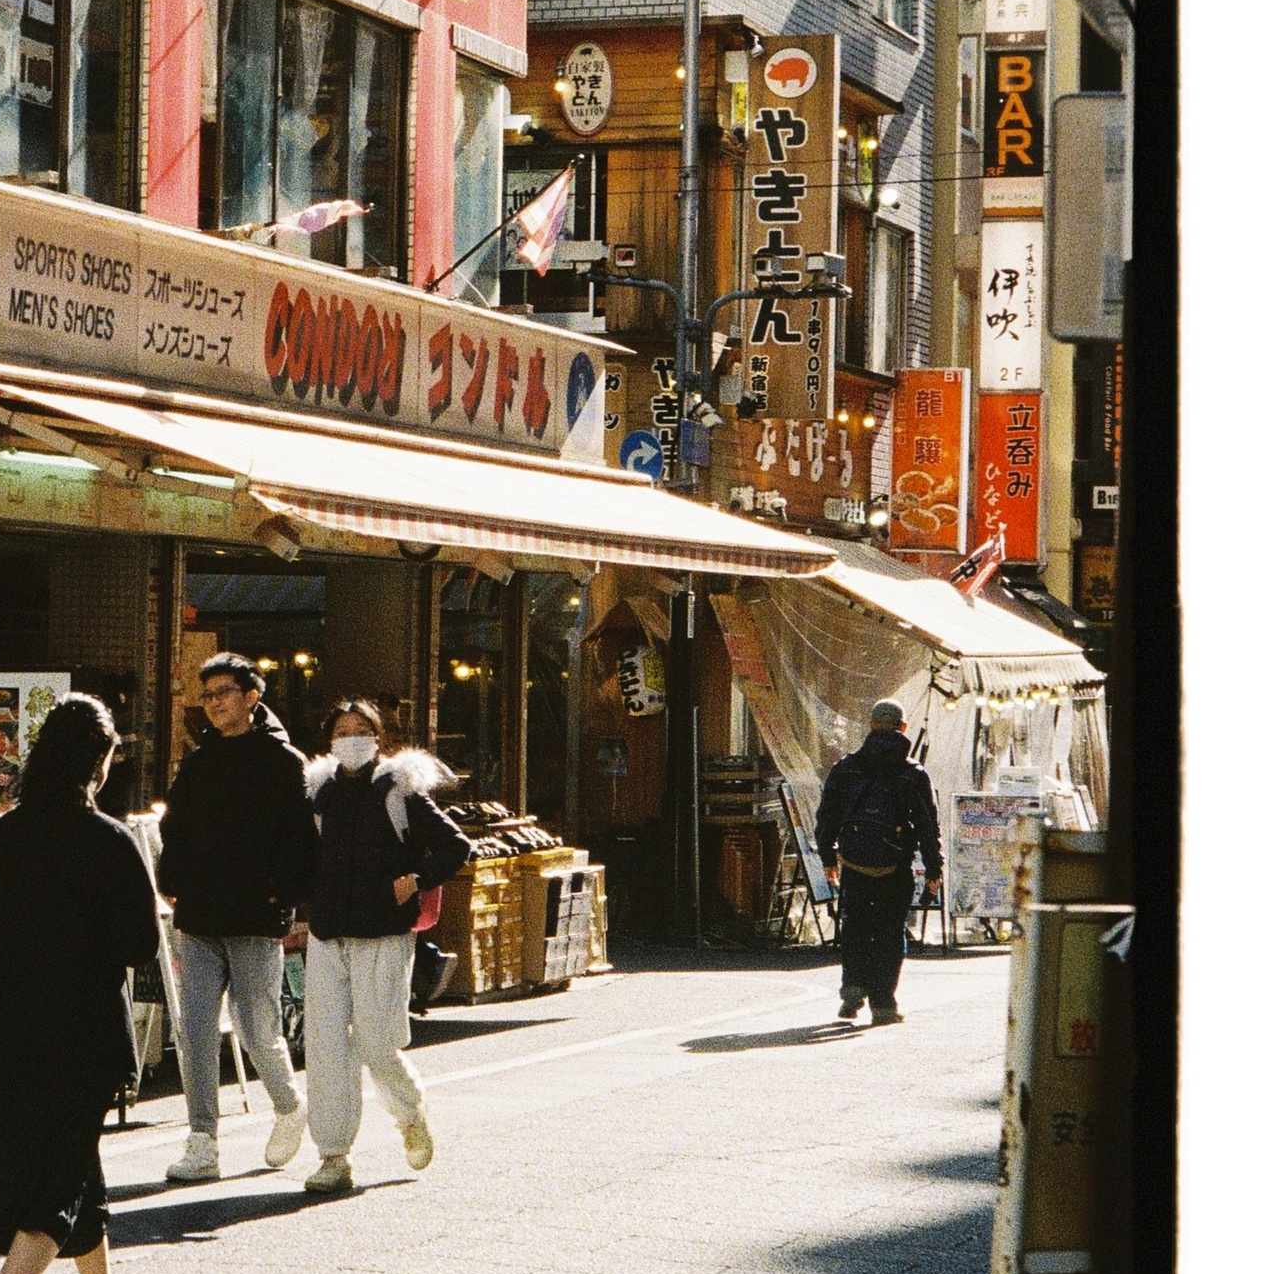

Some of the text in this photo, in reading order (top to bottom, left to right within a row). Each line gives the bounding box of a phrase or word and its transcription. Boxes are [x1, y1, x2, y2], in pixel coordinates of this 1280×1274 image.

[1007, 33, 1026, 44] 4F
[995, 55, 1035, 166] BAR
[751, 107, 809, 347] やきとん
[13, 235, 133, 296] SPORTS SHOES
[143, 268, 247, 321] スポーツシューズ
[8, 286, 116, 343] MEN'S SHOES
[985, 267, 1021, 342] 伊吹
[142, 321, 234, 368] メンズシューズ
[263, 279, 406, 416] CONDOR
[943, 371, 962, 383] B1
[428, 323, 551, 440] コンドル
[750, 354, 770, 412] 新宿店
[1005, 403, 1036, 498] 立呑み
[983, 462, 1003, 538] ひなど
